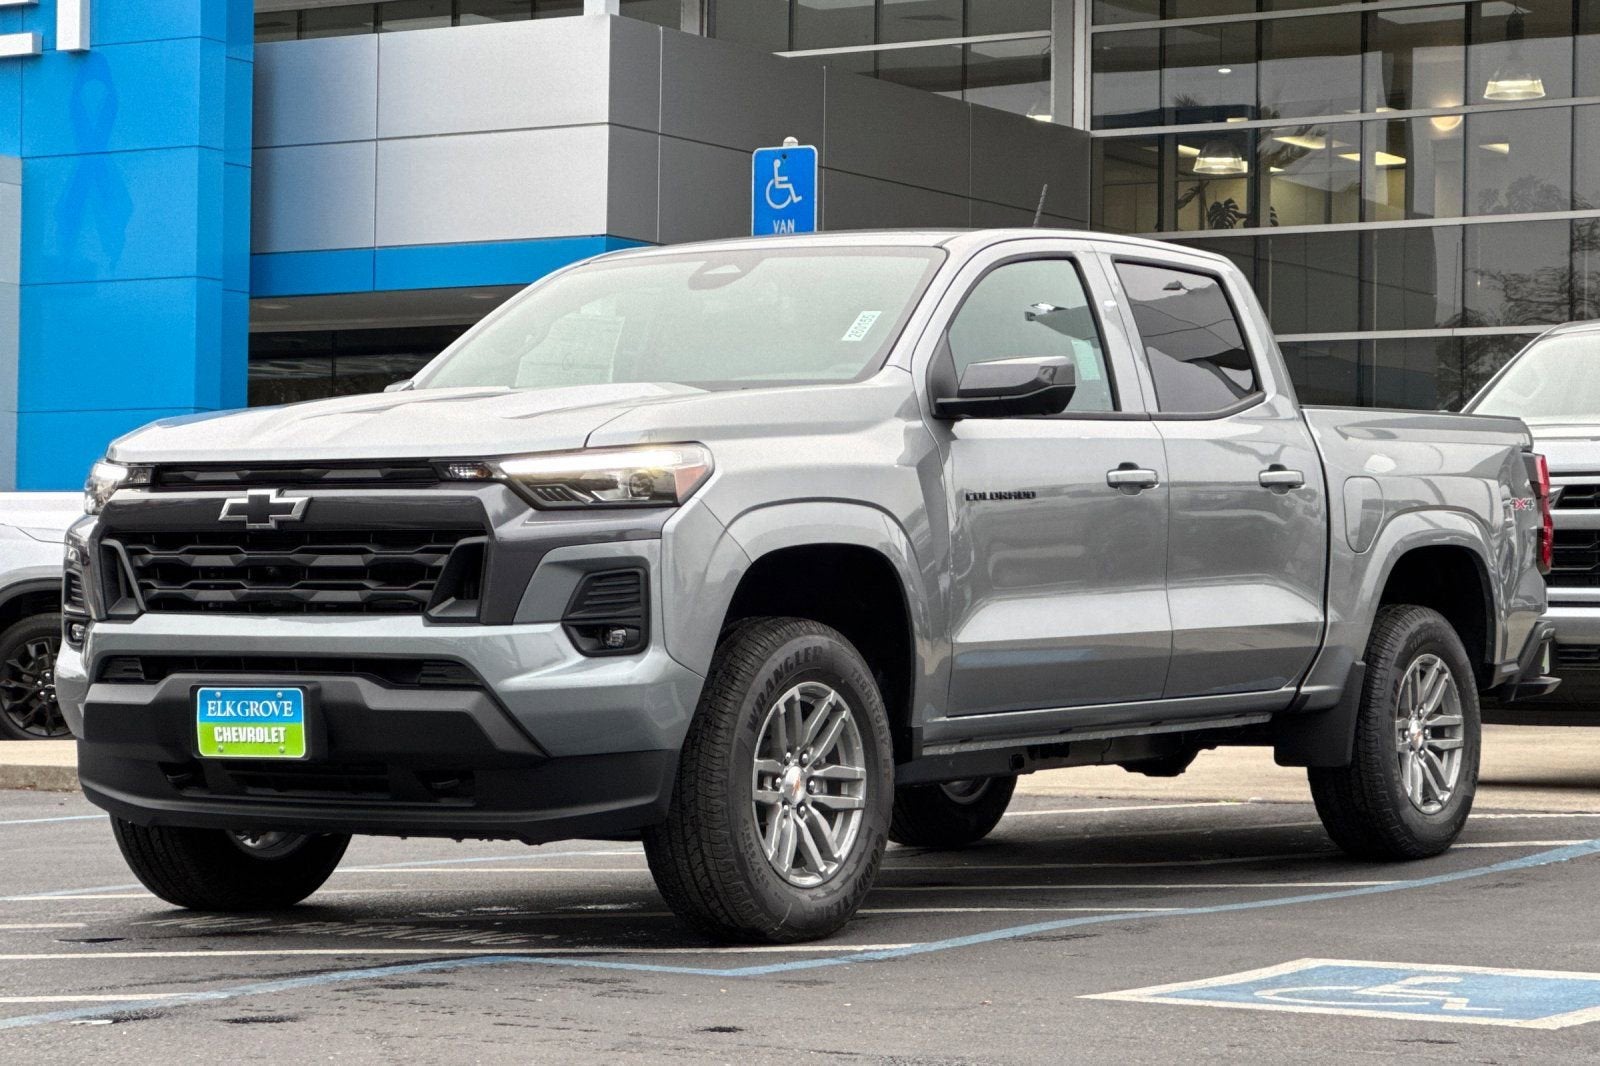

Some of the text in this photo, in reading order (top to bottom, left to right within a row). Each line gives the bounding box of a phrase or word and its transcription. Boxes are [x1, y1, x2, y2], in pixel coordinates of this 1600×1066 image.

[772, 218, 795, 234] VAN
[965, 490, 1036, 501] COLORADO
[746, 645, 824, 734] WRANGLER
[850, 666, 889, 745] TERRITORY
[213, 726, 287, 744] CHEVROLET
